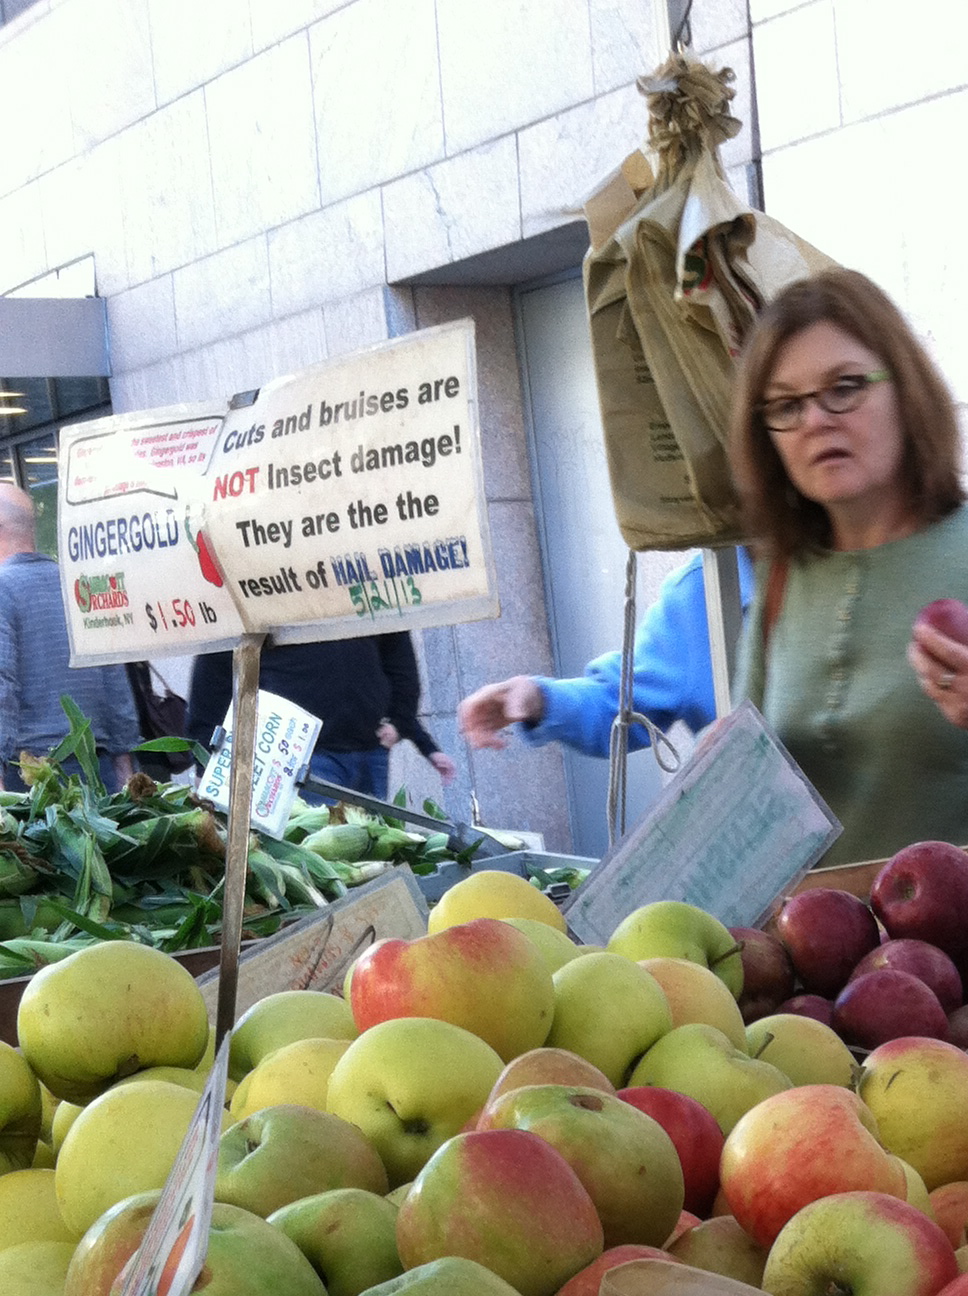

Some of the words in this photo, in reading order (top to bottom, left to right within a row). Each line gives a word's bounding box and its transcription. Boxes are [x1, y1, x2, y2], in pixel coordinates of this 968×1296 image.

[223, 422, 266, 454] Cuts
[271, 404, 312, 439] and
[319, 387, 409, 427] bruises
[418, 375, 460, 405] are
[212, 467, 259, 501] NOT
[267, 451, 342, 490] Insect
[350, 425, 461, 473] damage!
[68, 509, 179, 562] GINGERGOLD
[236, 519, 293, 548] They
[301, 511, 340, 537] are
[347, 499, 388, 529] the
[396, 490, 439, 520] the
[238, 564, 302, 598] result
[306, 561, 329, 589] of
[330, 552, 378, 586] HAIL
[377, 535, 470, 579] DAMAGE!
[199, 601, 217, 624] lb
[258, 712, 282, 754] CORN
